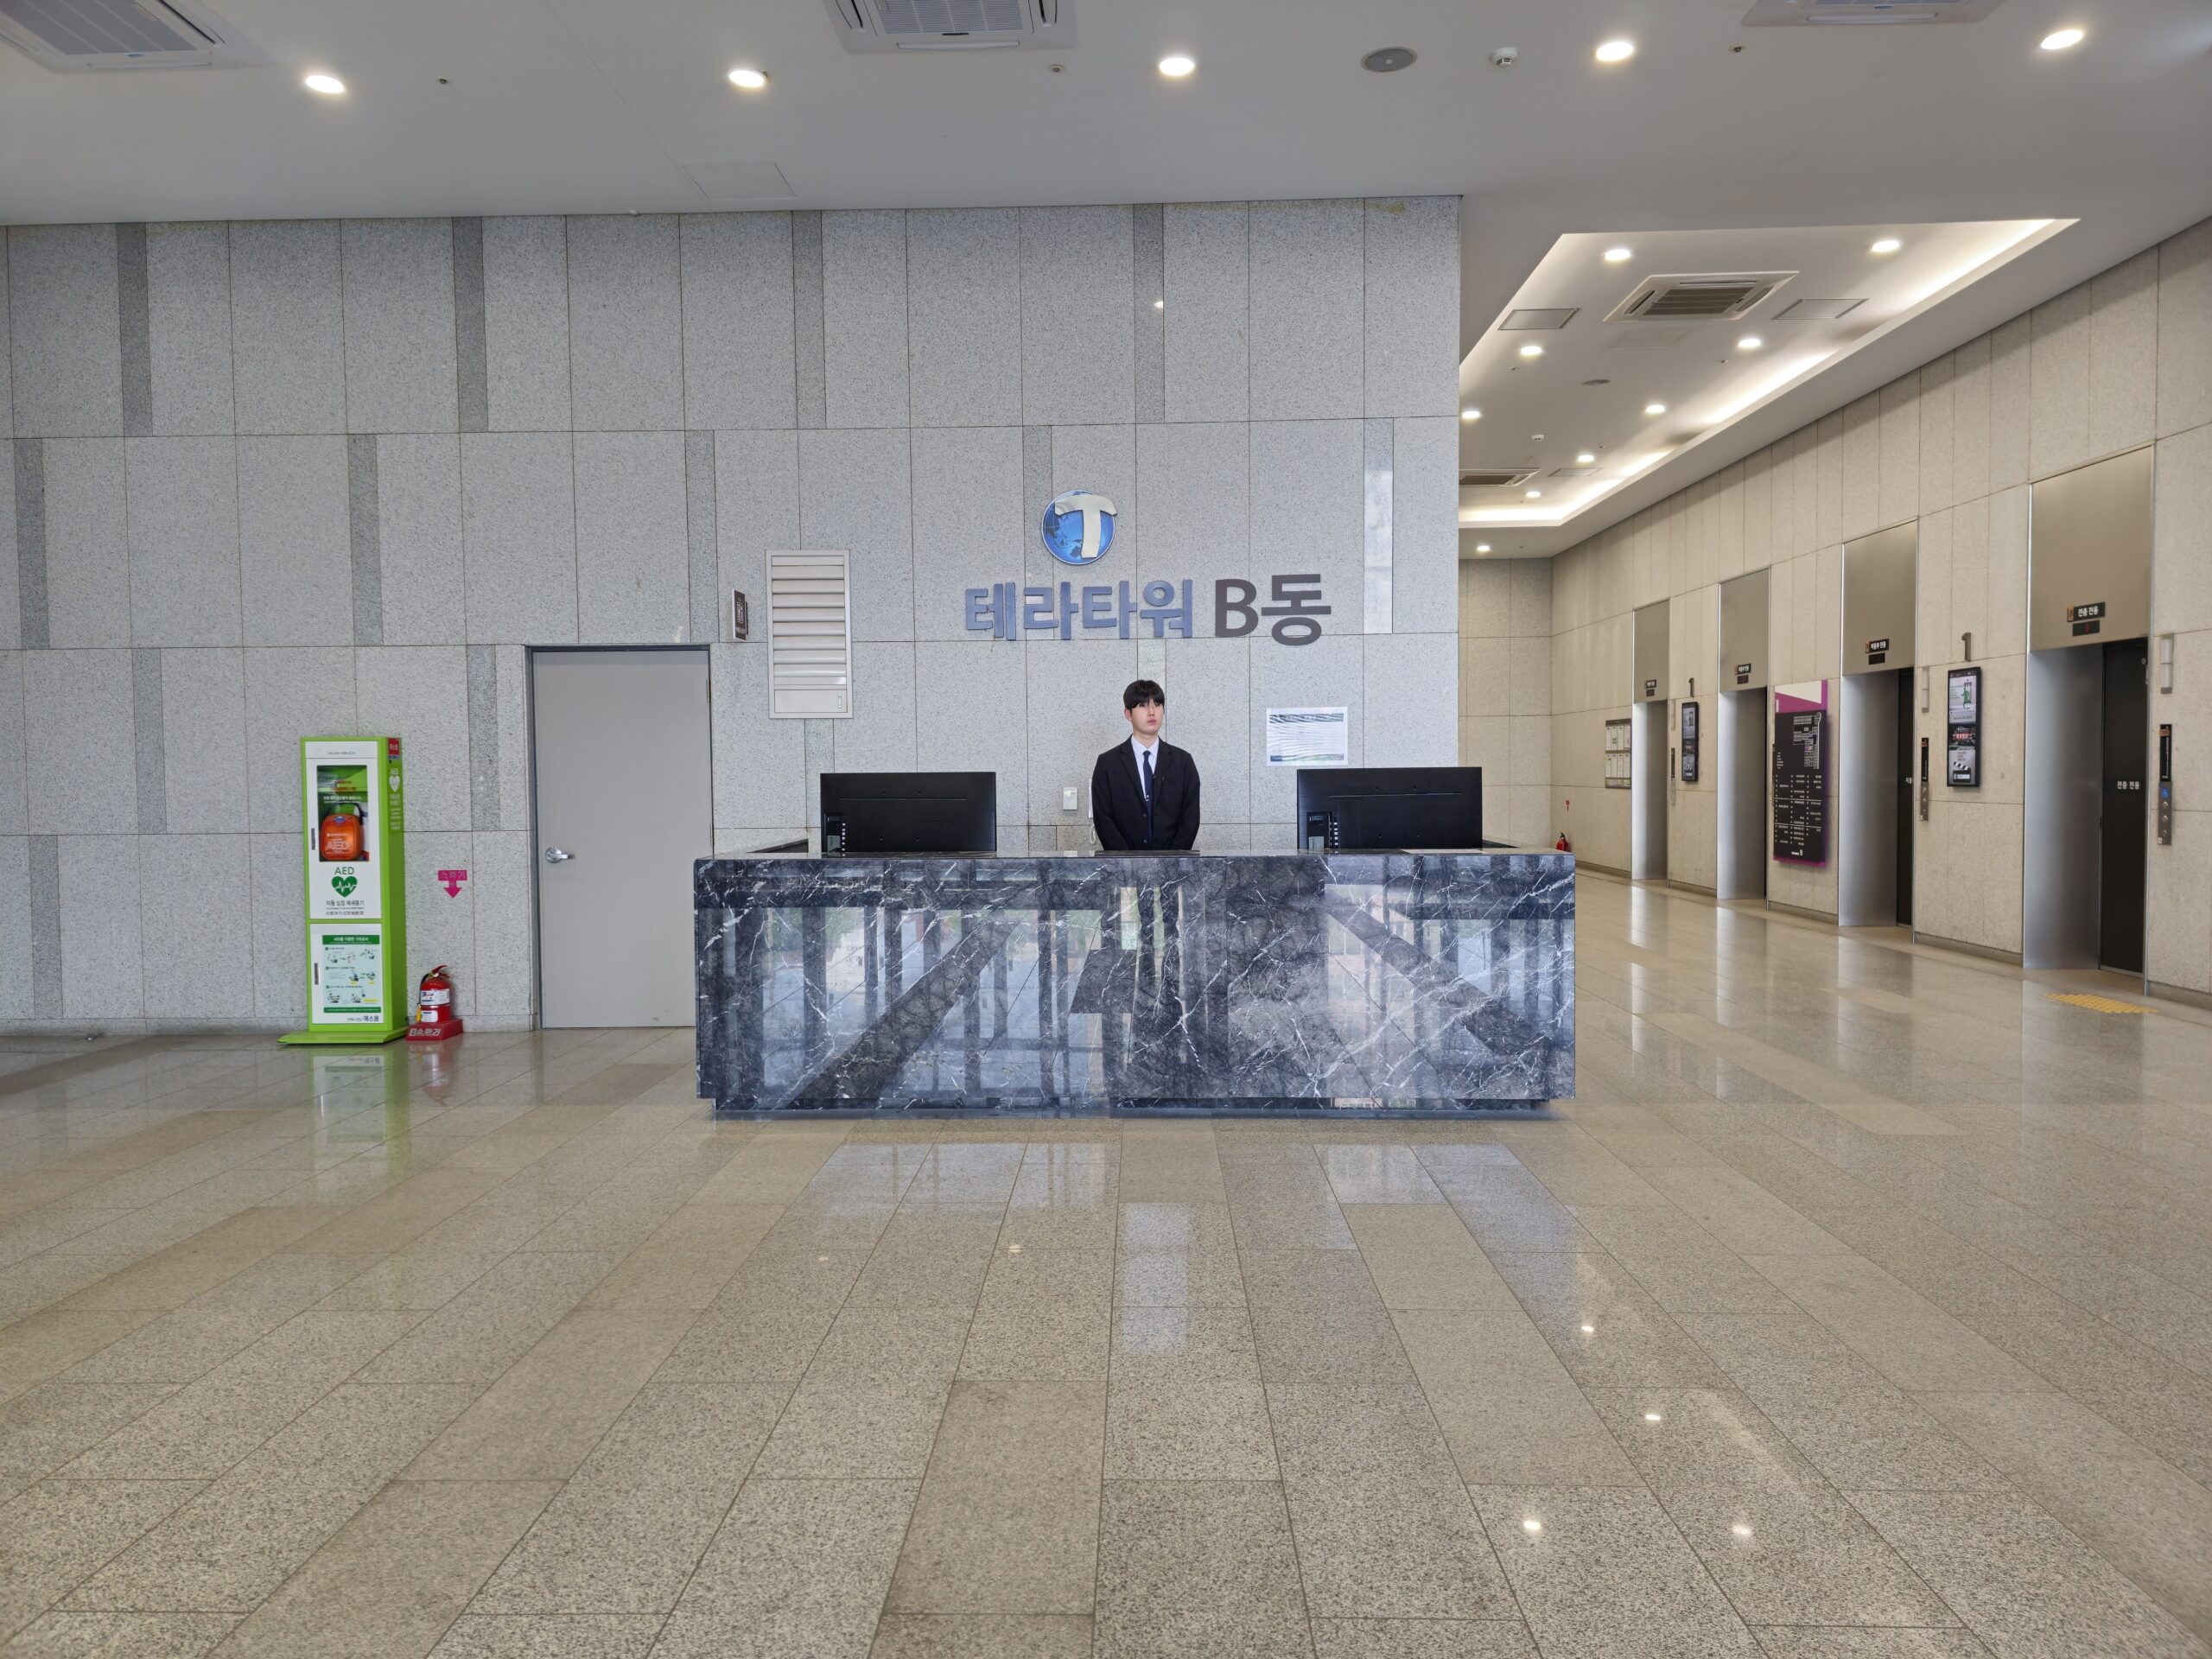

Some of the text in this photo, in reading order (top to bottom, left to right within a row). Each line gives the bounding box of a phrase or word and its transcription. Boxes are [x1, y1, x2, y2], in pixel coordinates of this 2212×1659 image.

[965, 573, 1332, 646] 테라타워 B동
[2088, 605, 2099, 616] 전용
[1961, 632, 1972, 662] 1
[2129, 780, 2140, 790] 전용
[334, 866, 355, 875] AED
[439, 870, 467, 880] 소화기
[416, 1027, 441, 1037] 소화기
